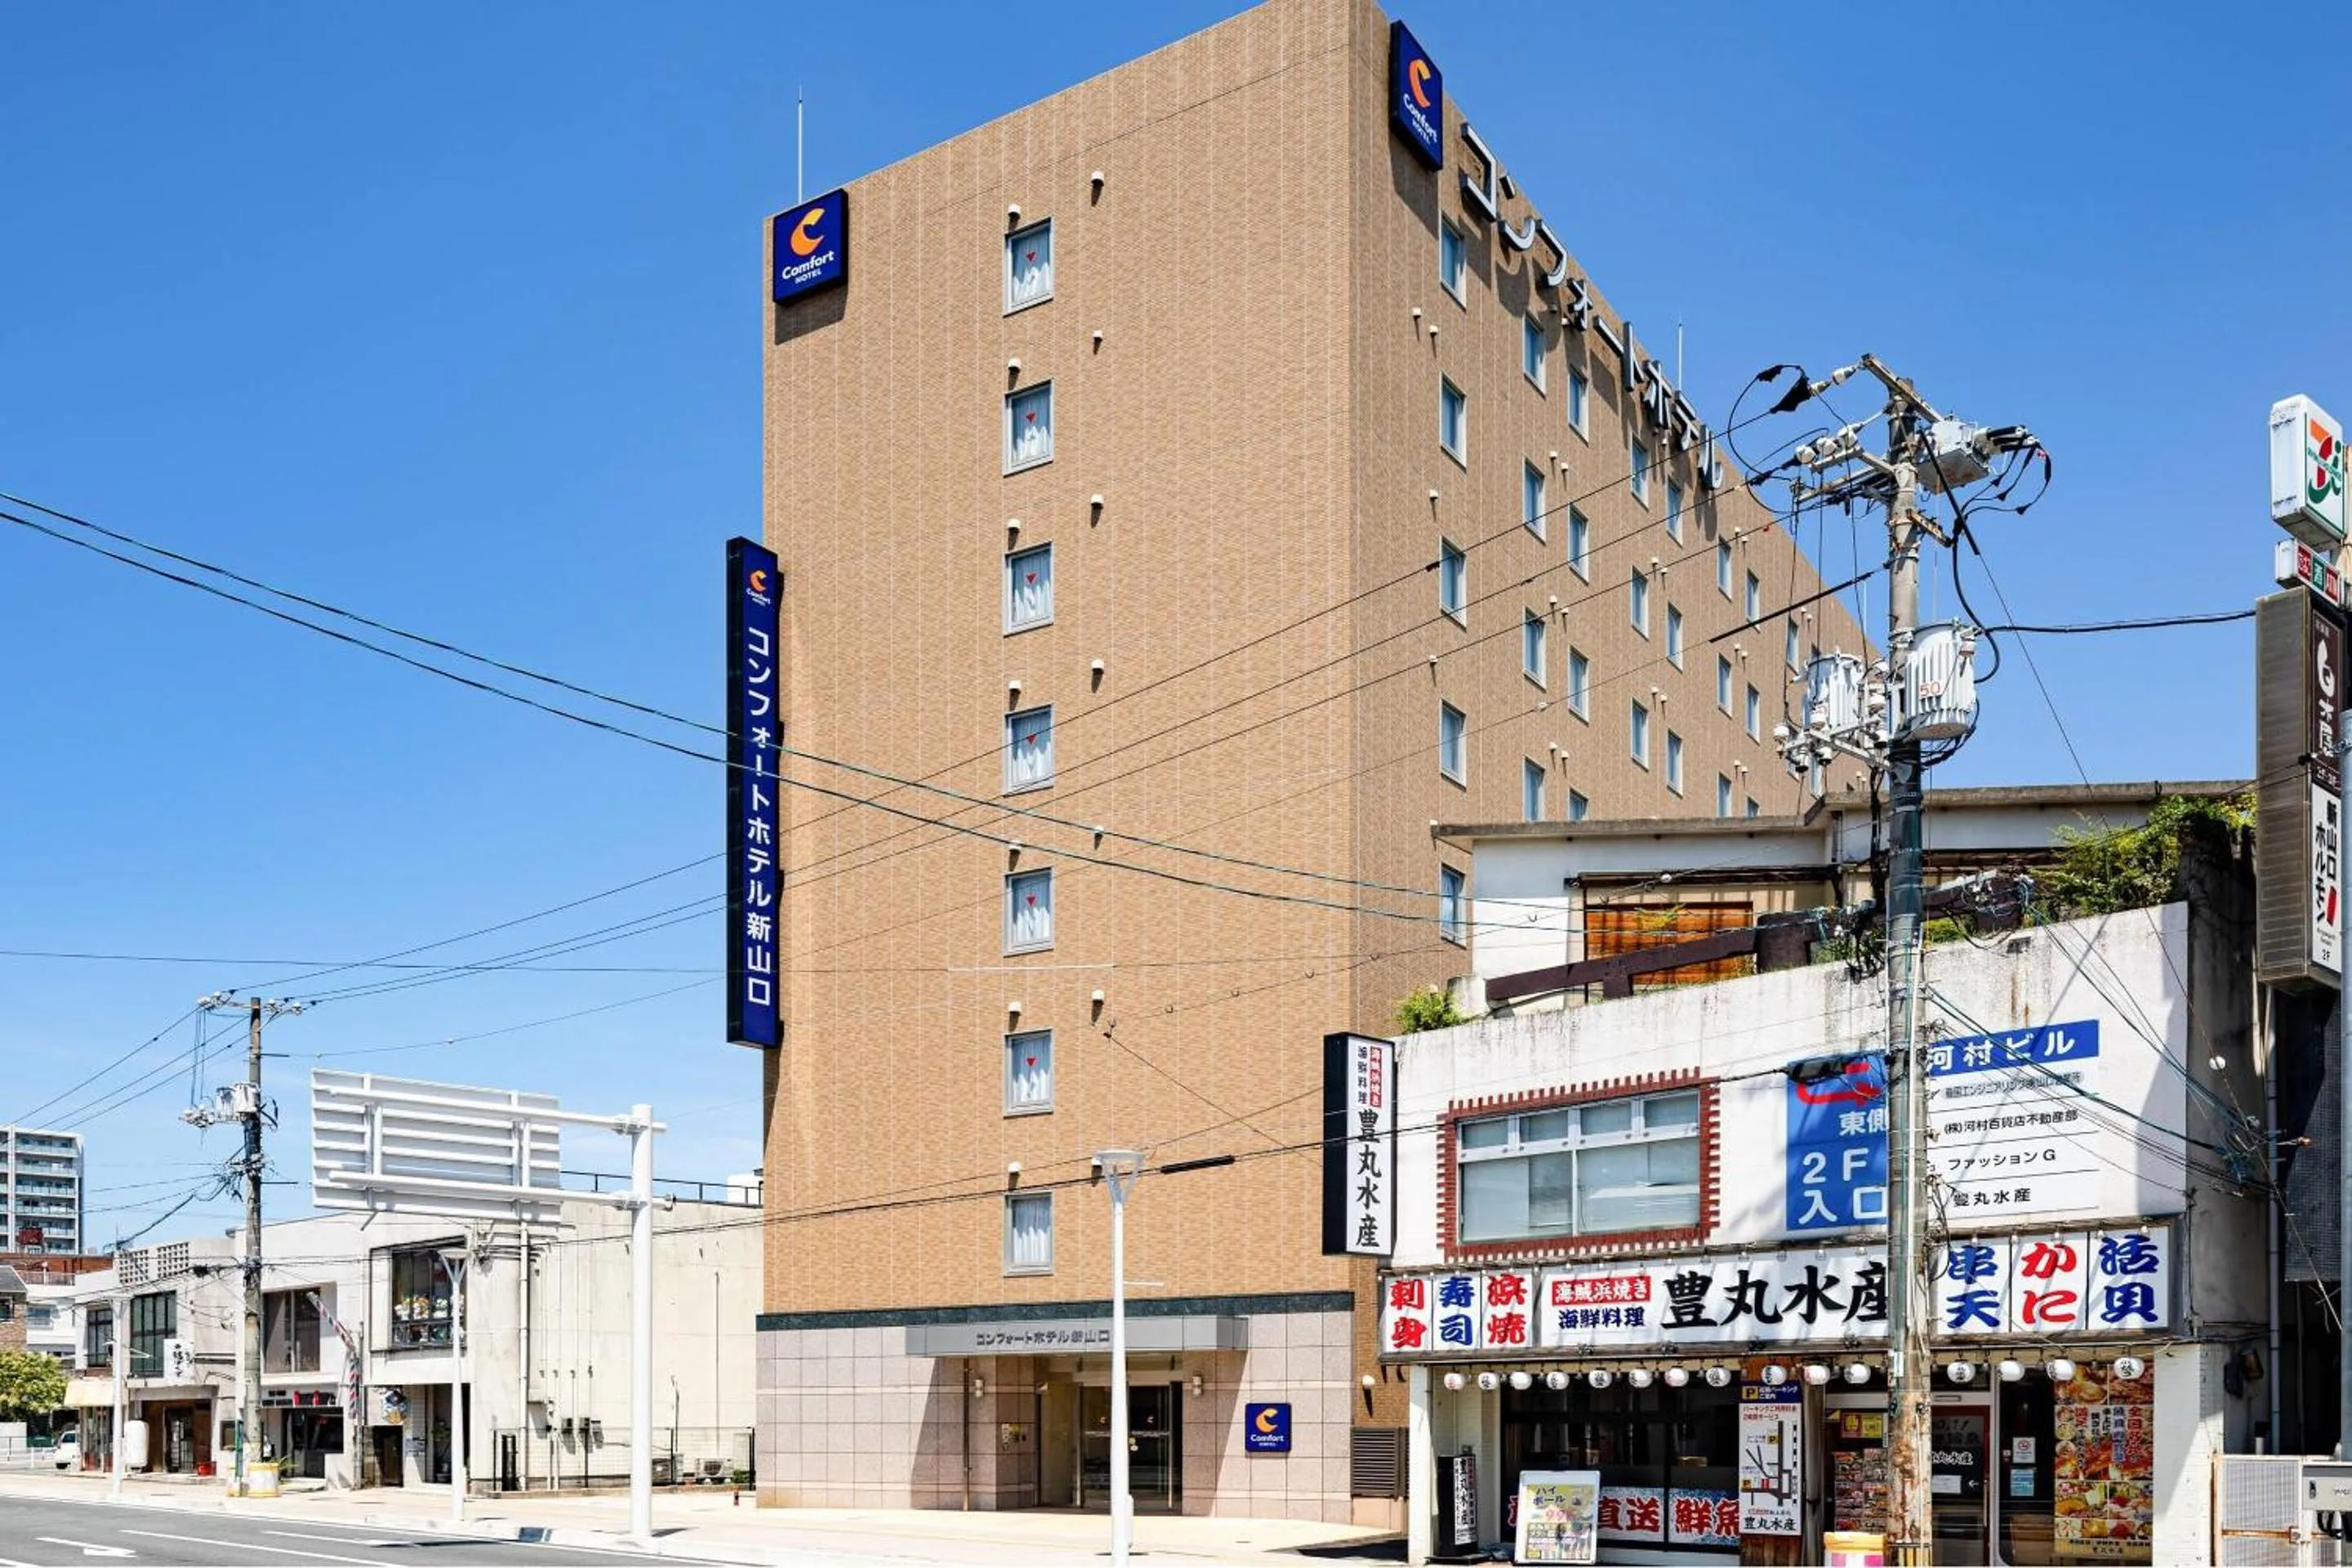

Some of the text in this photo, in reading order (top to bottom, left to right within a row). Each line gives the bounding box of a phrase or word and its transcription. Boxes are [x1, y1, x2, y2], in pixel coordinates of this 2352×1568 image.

[1403, 93, 1437, 143] Comfort
[782, 250, 834, 279] Comfort
[1460, 122, 1724, 489] コンフォートホテル
[1920, 681, 1940, 697] 50
[746, 626, 773, 1006] コンフォートホテル新山口
[1927, 1030, 2075, 1071] 河村ビル
[1839, 1107, 1890, 1136] 東側
[1356, 1108, 1382, 1248] 豊丸水産
[1802, 1147, 1869, 1184] 2F
[1797, 1186, 1889, 1225] 入口
[1554, 1277, 1649, 1304] 海賊浜焼き
[1660, 1261, 1889, 1330] 豊丸水産
[1946, 1245, 2000, 1329] 串天
[2021, 1241, 2078, 1325] かに
[2098, 1234, 2160, 1323] 活貝
[976, 1329, 1111, 1346] コンフォートホテル新山口
[1390, 1279, 1427, 1348] 刺身
[1439, 1276, 1475, 1346] 寿司
[1487, 1273, 1528, 1344] 浜焼
[1557, 1307, 1646, 1330] 海鮮料理
